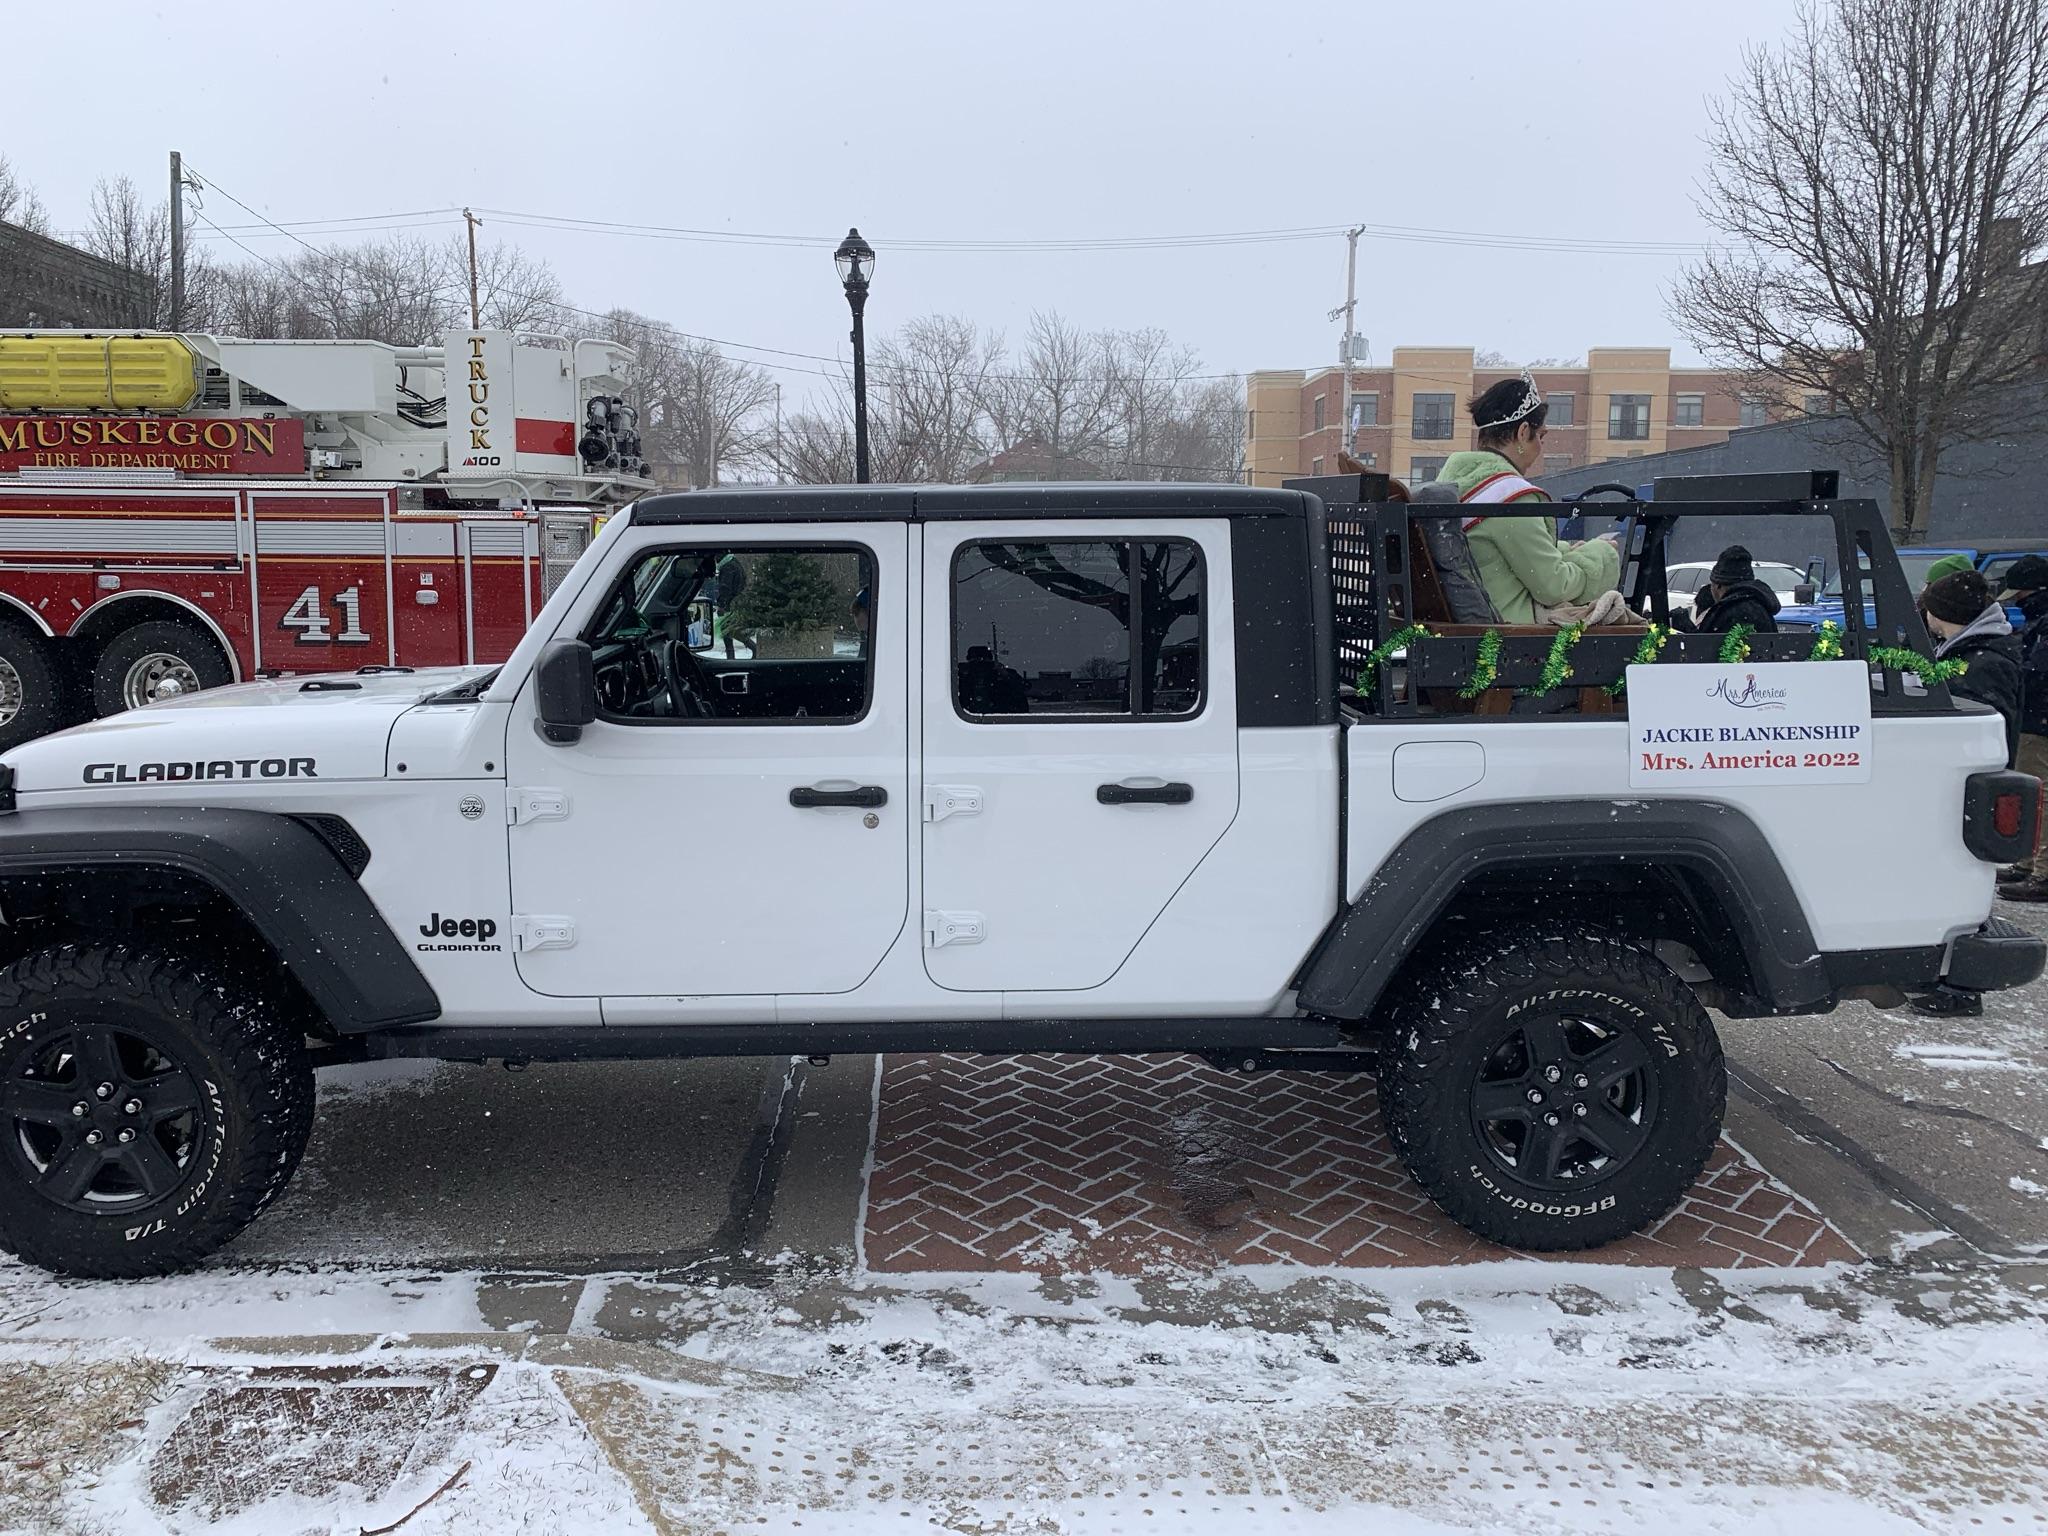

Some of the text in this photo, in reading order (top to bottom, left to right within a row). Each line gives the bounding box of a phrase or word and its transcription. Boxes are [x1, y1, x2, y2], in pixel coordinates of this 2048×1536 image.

[467, 336, 492, 450] TRUCK
[0, 420, 277, 455] MUSKEGON
[34, 452, 233, 470] FIRE DEPARTMENT
[279, 585, 371, 645] 41
[1642, 725, 1861, 743] JACKIE BLANKENSHIP
[83, 757, 318, 784] GLADIATOR
[1641, 750, 1860, 771] Mrs. America 2022
[419, 912, 497, 942] Jeep
[417, 944, 501, 952] GLADIATOR
[1506, 989, 1679, 1058] All-Terrain T/A
[124, 1079, 226, 1241] All-Terrain T/A
[1470, 1165, 1616, 1218] BFGoodrich
